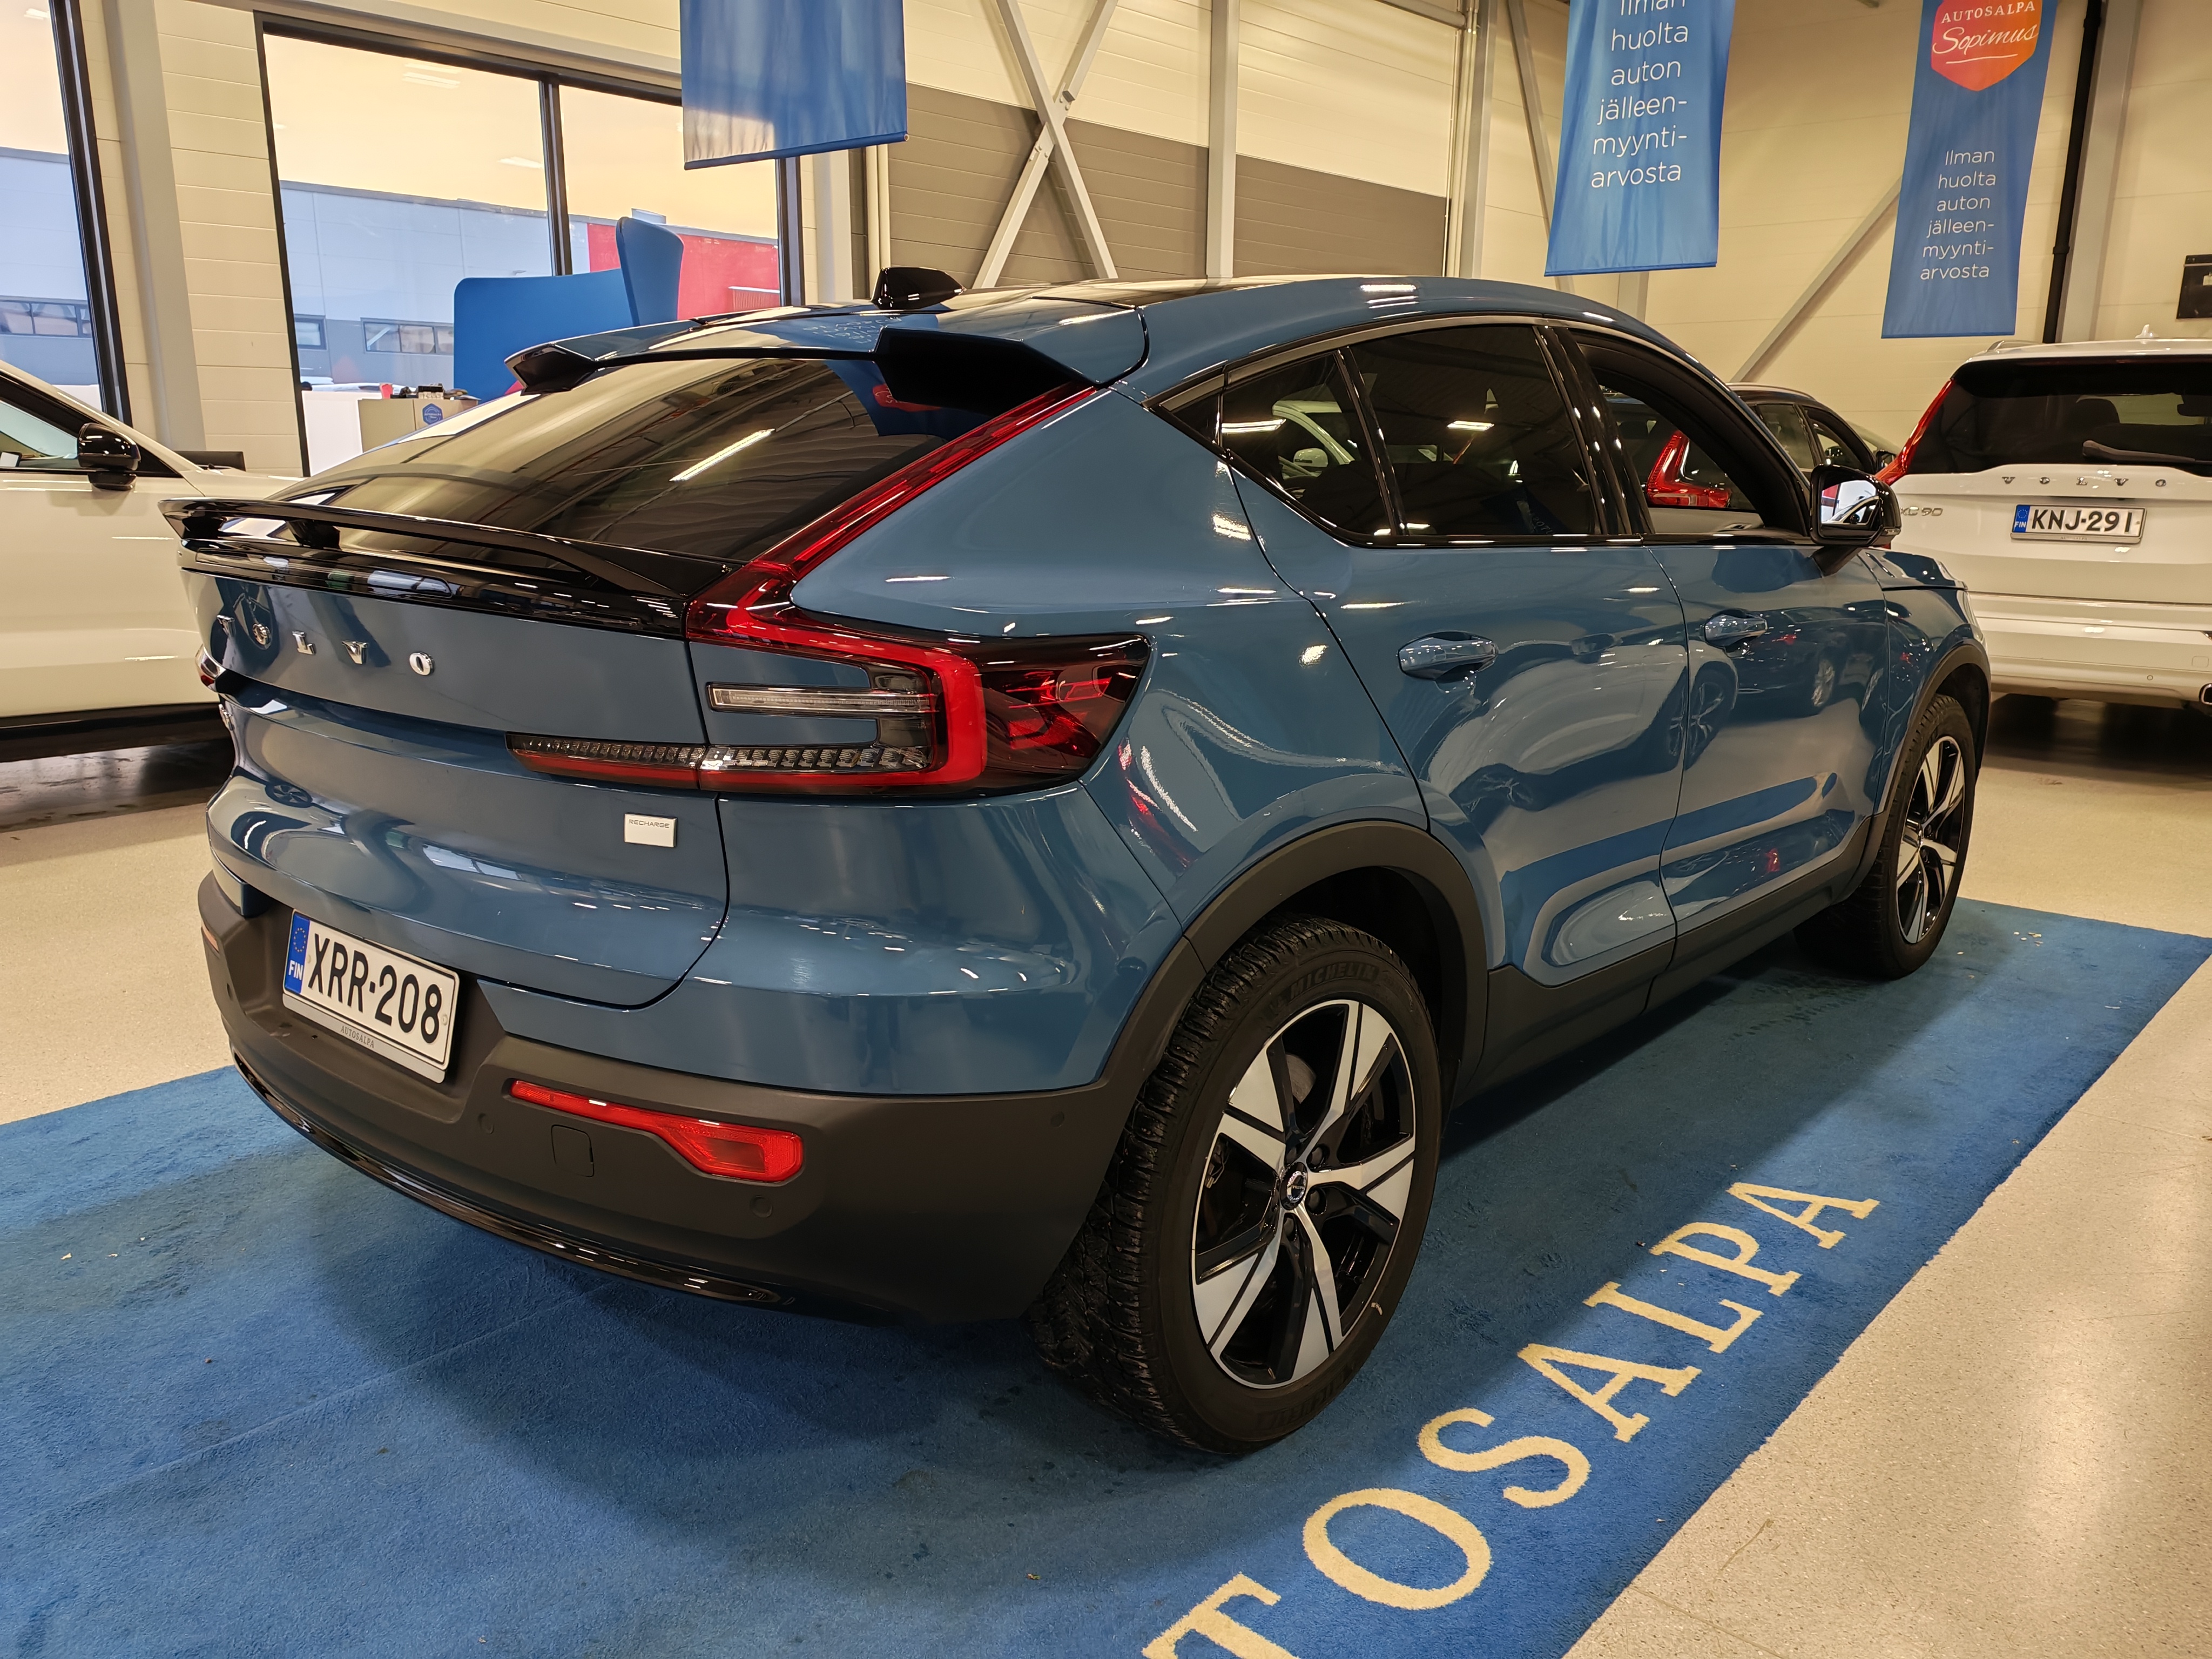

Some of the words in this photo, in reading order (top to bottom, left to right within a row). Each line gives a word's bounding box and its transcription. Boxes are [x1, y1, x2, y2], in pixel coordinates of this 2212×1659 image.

[1940, 1, 2035, 24] AUTOSALPA
[1611, 22, 1688, 51] huolta
[1932, 24, 2039, 55] Sopimus
[1611, 60, 1681, 86] auton
[1596, 95, 1688, 125] jälleen-
[1593, 125, 1688, 158] myynti-
[1945, 150, 1995, 166] Ilman
[1590, 161, 1682, 188] arvosta
[1938, 171, 1996, 189] huolta
[1937, 195, 1991, 212] auton
[1926, 218, 1994, 238] jälleen-
[1923, 240, 1994, 260] myynti-
[1920, 264, 1990, 280] arvosta
[2001, 476, 2167, 487] VOLVO
[2031, 509, 2133, 532] KNJ-291
[217, 615, 435, 676] VOLVO
[629, 819, 670, 828] RECHARGE
[288, 960, 304, 980] FIN
[308, 933, 442, 1044] XRR-208
[1290, 961, 1377, 1000] MICHELIN
[340, 1025, 375, 1048] AUTOSALPA
